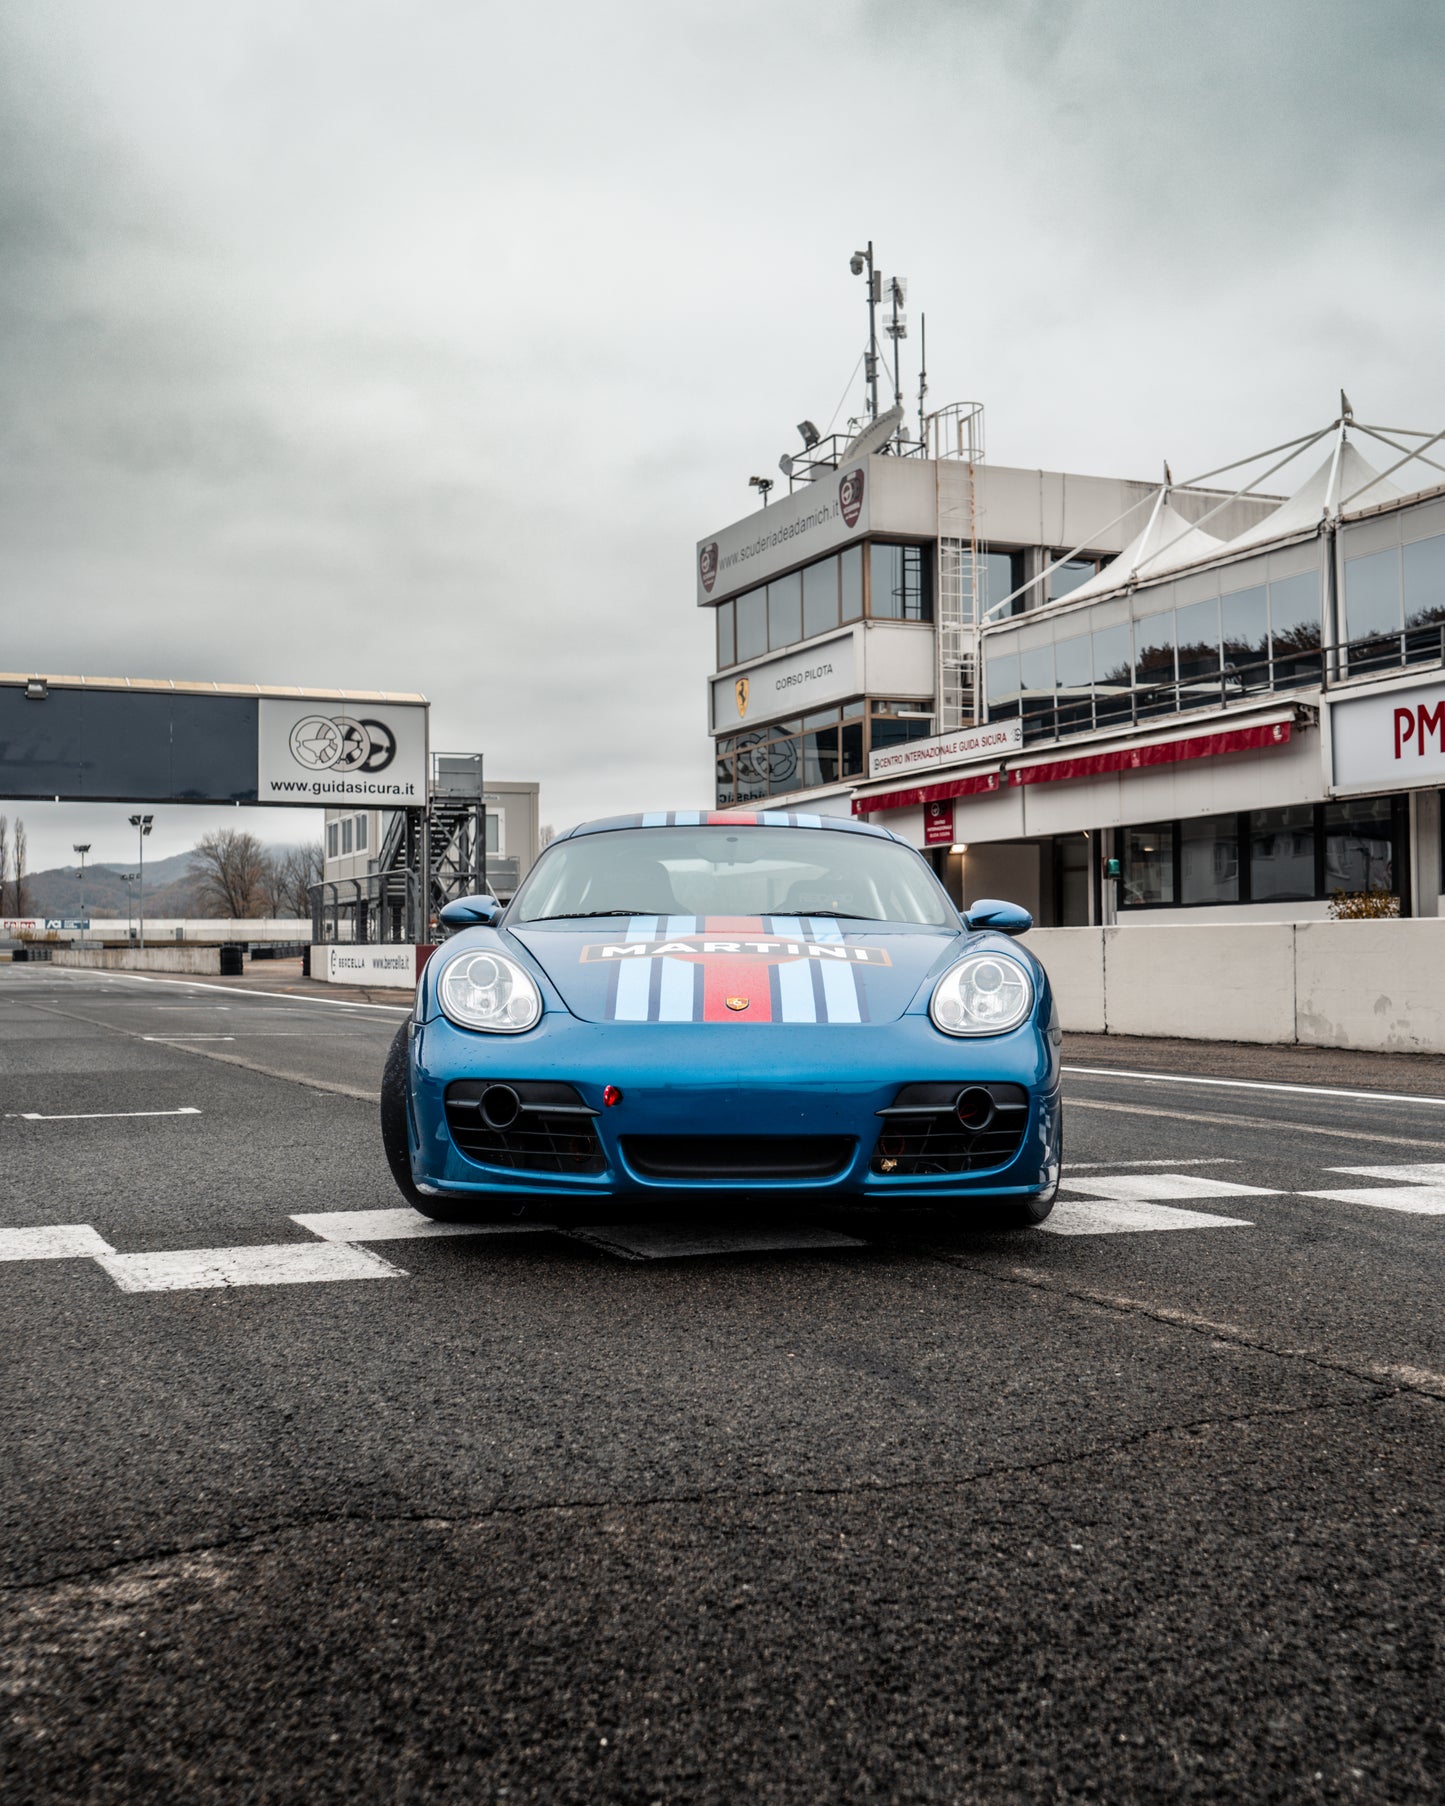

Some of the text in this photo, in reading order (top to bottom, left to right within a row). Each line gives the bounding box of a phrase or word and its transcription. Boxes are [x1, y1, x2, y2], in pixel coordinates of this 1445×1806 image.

[719, 500, 839, 571] www.scuderiadeadamich.it
[775, 664, 833, 690] CORSO PILOTA
[880, 732, 1007, 768] CENTRO INTERNAZIONALE GUIDA SICURA
[270, 780, 415, 796] www.guidasicura.it
[601, 942, 869, 961] MARTINI
[338, 958, 365, 968] BERCELLA
